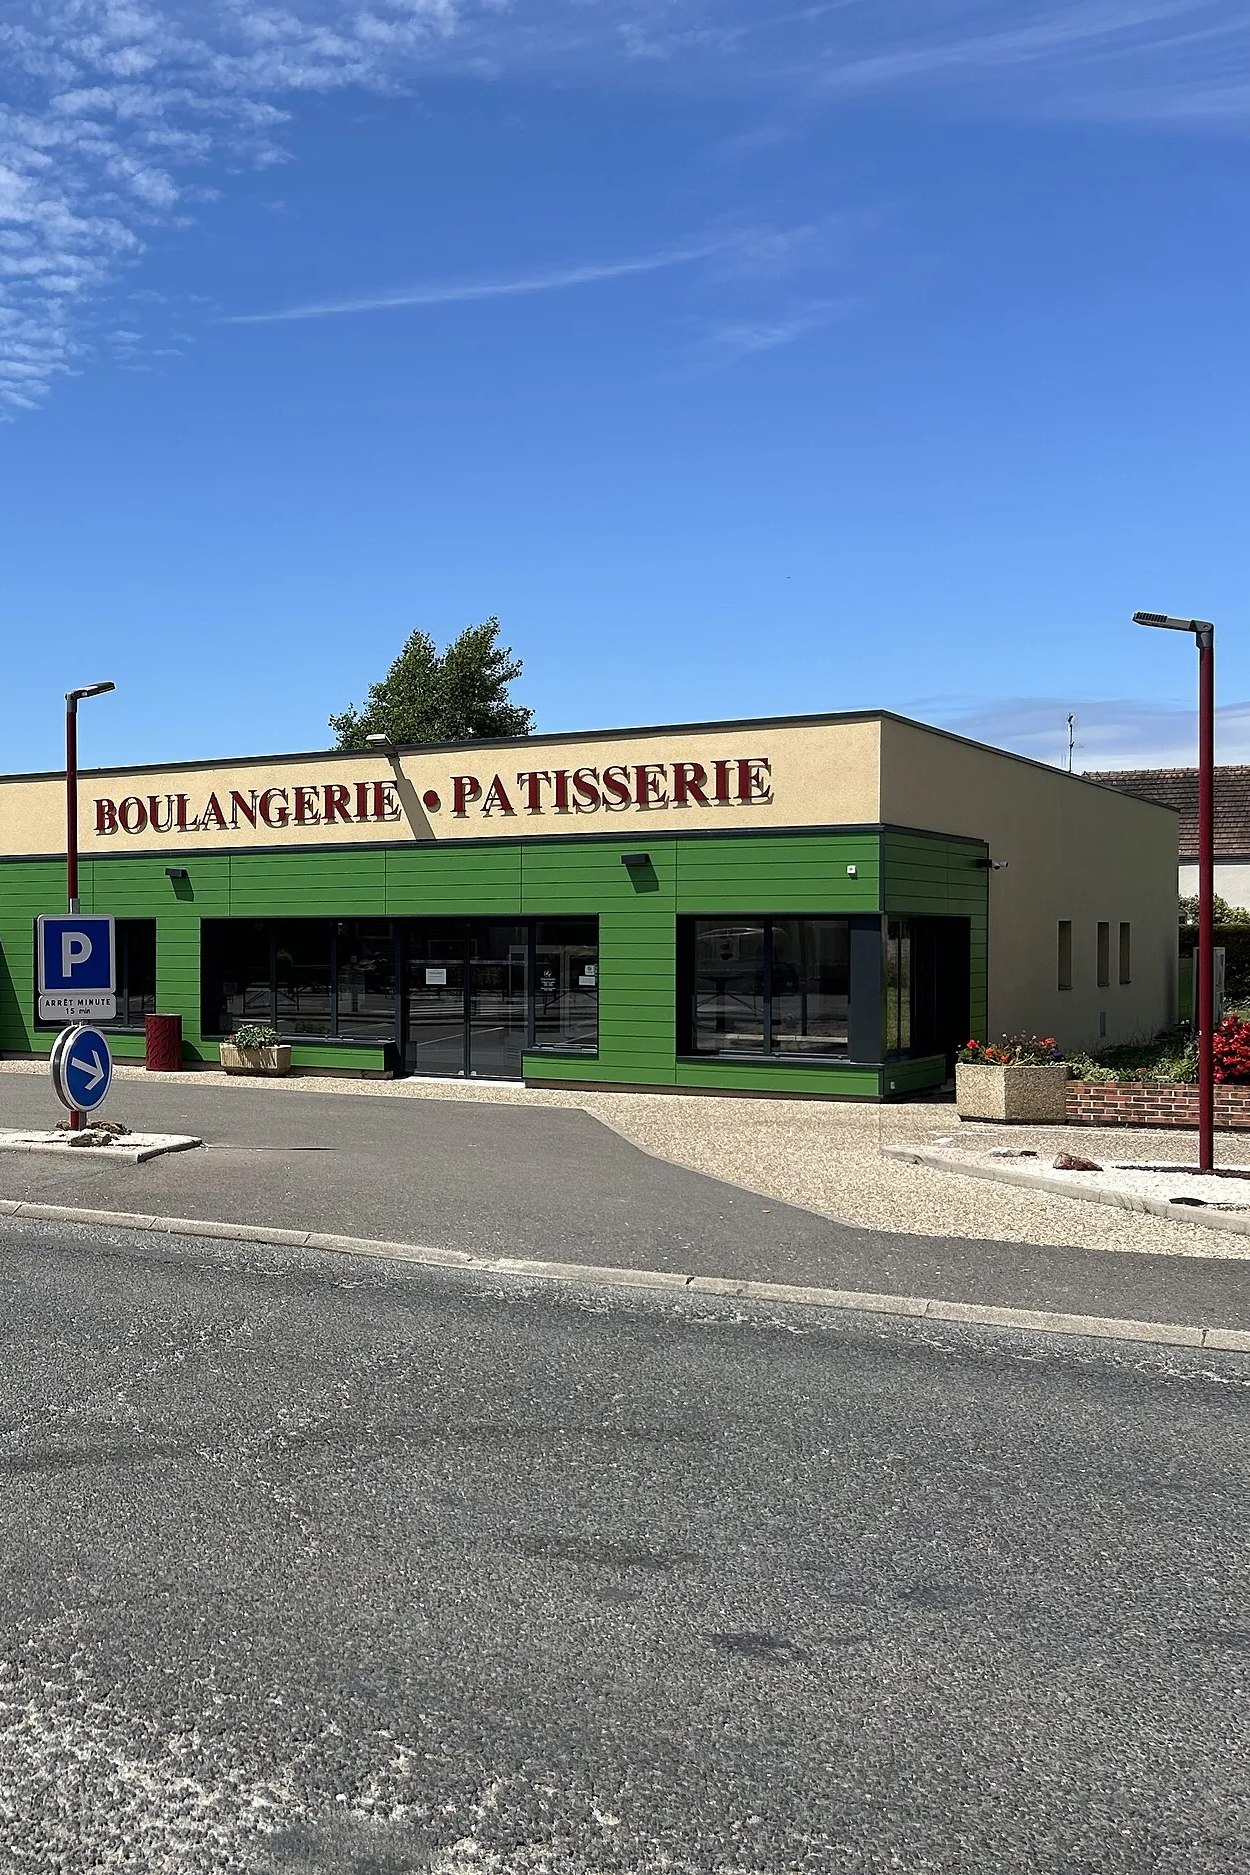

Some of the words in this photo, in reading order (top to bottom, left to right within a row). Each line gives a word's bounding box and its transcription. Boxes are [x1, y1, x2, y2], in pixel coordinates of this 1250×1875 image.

[93, 780, 401, 834] BOULANGERIE
[450, 757, 772, 816] PATISSERIE
[61, 931, 93, 978] P
[45, 998, 74, 1007] ARRÊT
[77, 998, 111, 1006] MINUTE
